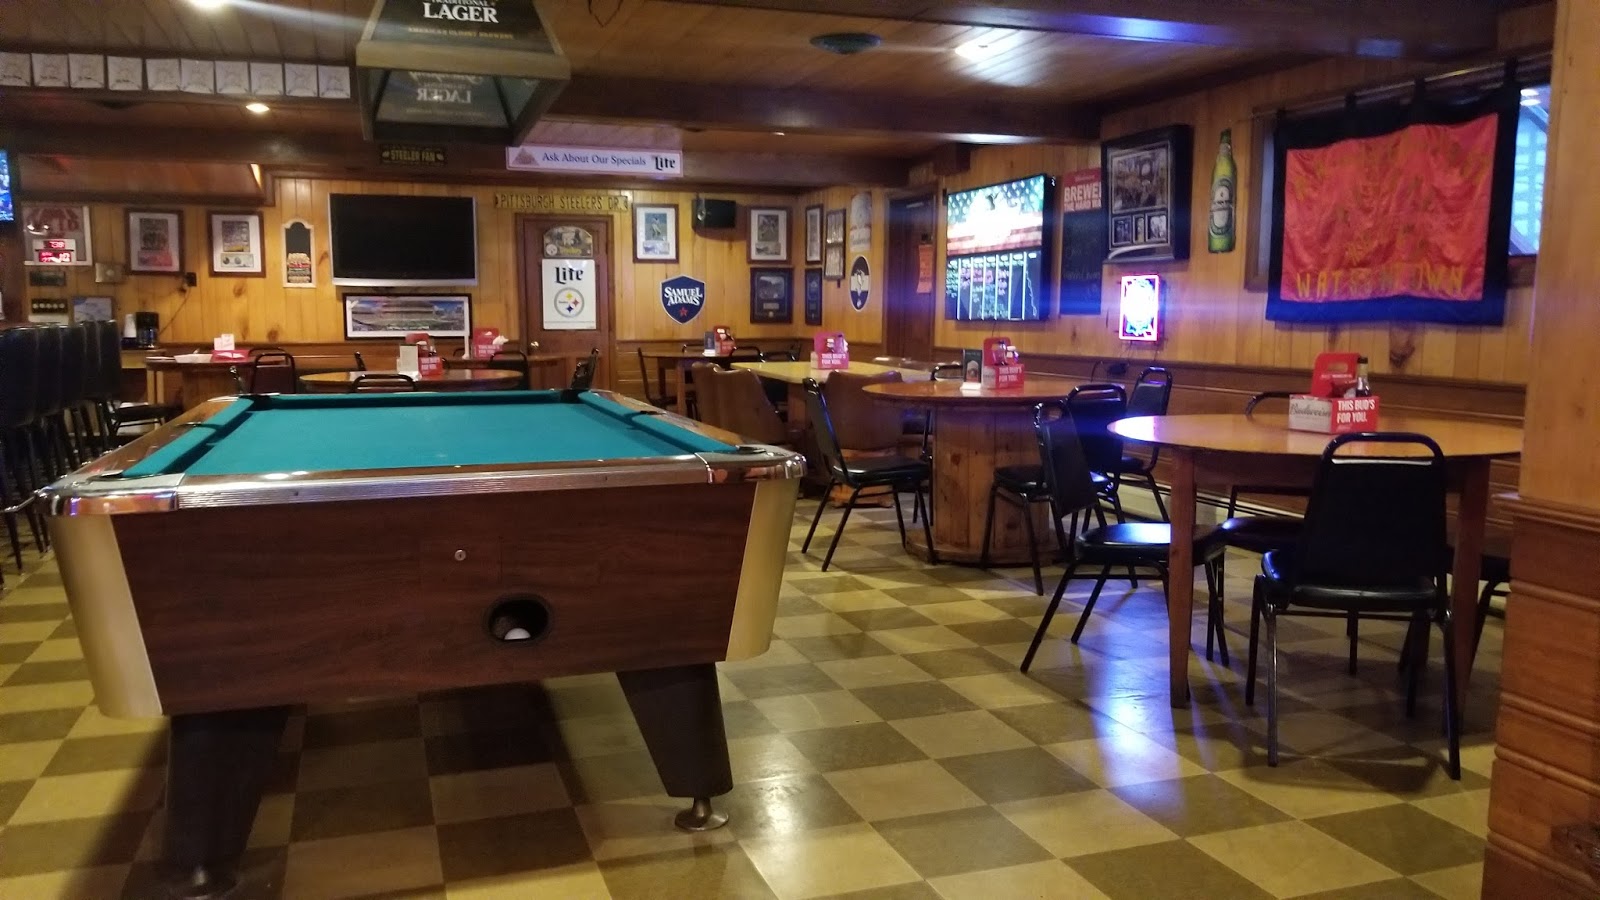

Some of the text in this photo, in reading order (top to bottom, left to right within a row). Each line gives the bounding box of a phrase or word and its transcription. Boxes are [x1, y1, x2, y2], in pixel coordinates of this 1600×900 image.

[423, 2, 499, 24] LAGER
[542, 152, 559, 162] Ask
[562, 153, 589, 164] About
[592, 154, 608, 164] Our
[611, 154, 646, 167] Specials
[654, 155, 676, 171] Lite
[1063, 181, 1102, 203] BREWE
[501, 193, 555, 209] PITTSBURGH
[560, 195, 602, 210] STEELERS
[555, 266, 584, 285] Lite
[664, 286, 703, 298] SAMUEL
[667, 295, 700, 306] ADAMS
[1337, 399, 1375, 411] THIS BUD'S
[1337, 412, 1351, 424] FOR
